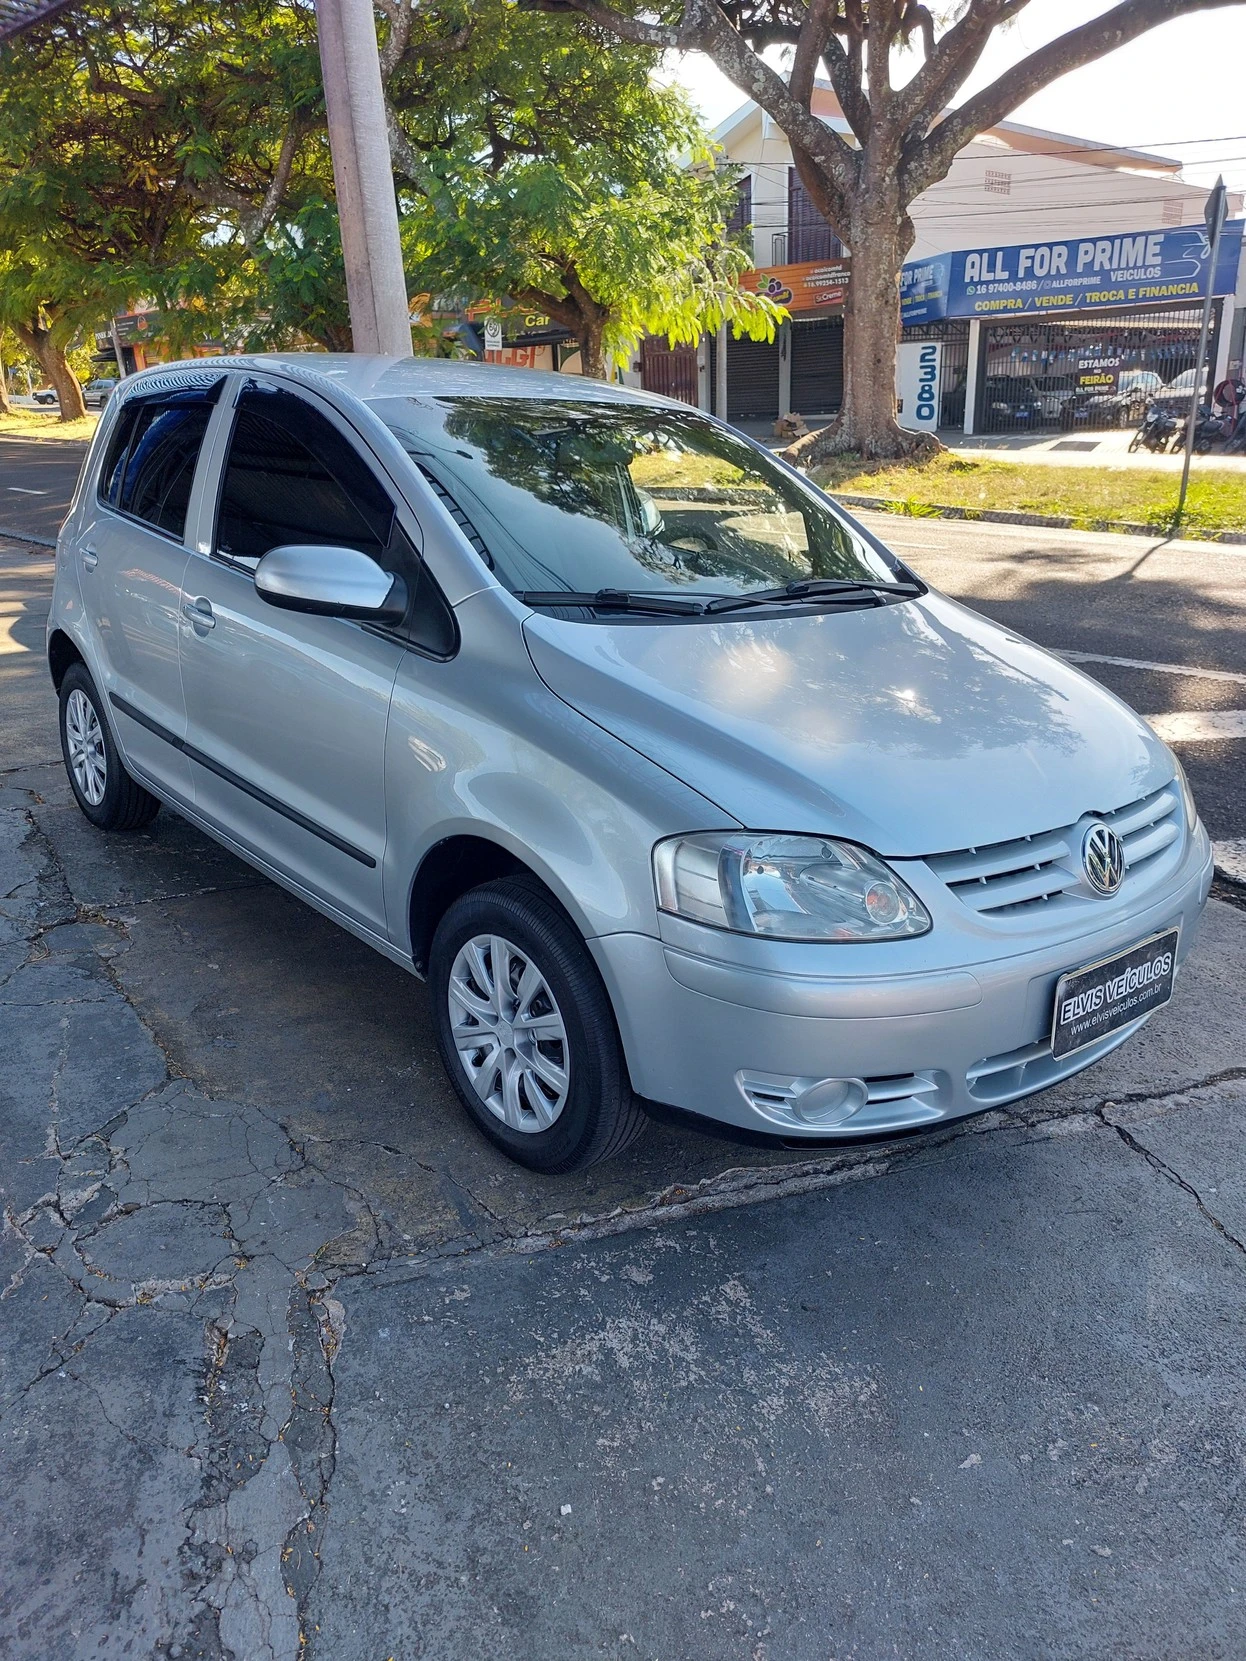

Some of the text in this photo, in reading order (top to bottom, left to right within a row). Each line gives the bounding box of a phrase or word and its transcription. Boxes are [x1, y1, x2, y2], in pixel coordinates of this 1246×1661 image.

[964, 234, 1164, 282] ALL FOR PRIME
[976, 284, 987, 294] 16
[988, 280, 1037, 293] 97400-8486
[1051, 276, 1101, 288] ALLFORPRIME
[1110, 267, 1161, 282] VEICULOS
[975, 298, 1023, 312] COMPRA
[1035, 293, 1073, 308] VENDE
[1085, 289, 1124, 303] TROCA
[1128, 288, 1136, 299] E
[1138, 282, 1199, 298] FINANCIA
[1078, 358, 1120, 369] ESTAMOS
[916, 345, 937, 421] 2380
[1080, 373, 1114, 385] FEIRÃO
[1060, 951, 1171, 1025] ELVIS VEÍCULOS
[1070, 982, 1162, 1036] www.elvisveiculos.com.br
